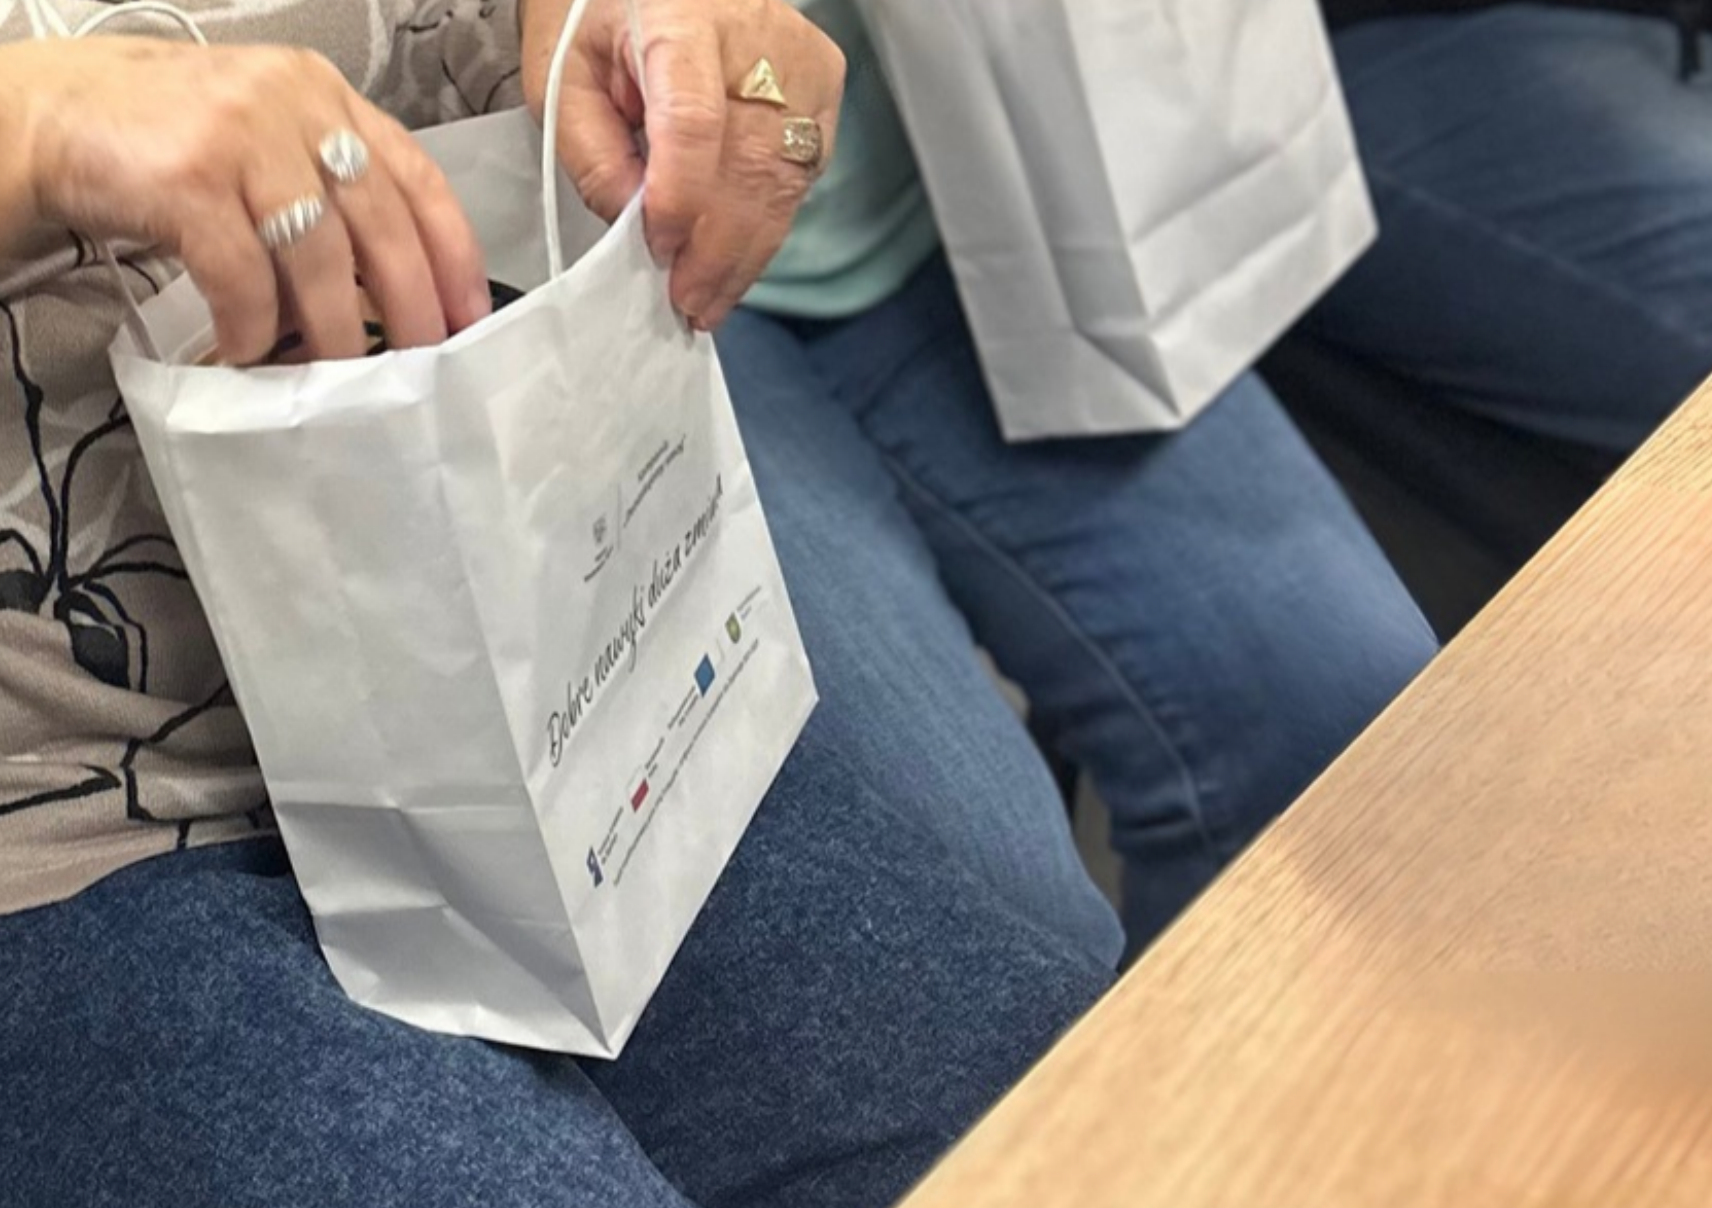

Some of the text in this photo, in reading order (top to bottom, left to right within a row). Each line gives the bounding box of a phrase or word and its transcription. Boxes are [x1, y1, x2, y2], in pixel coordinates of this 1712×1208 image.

[548, 680, 593, 768] Dobre
[595, 584, 646, 674] nawyki
[648, 542, 682, 609] duża
